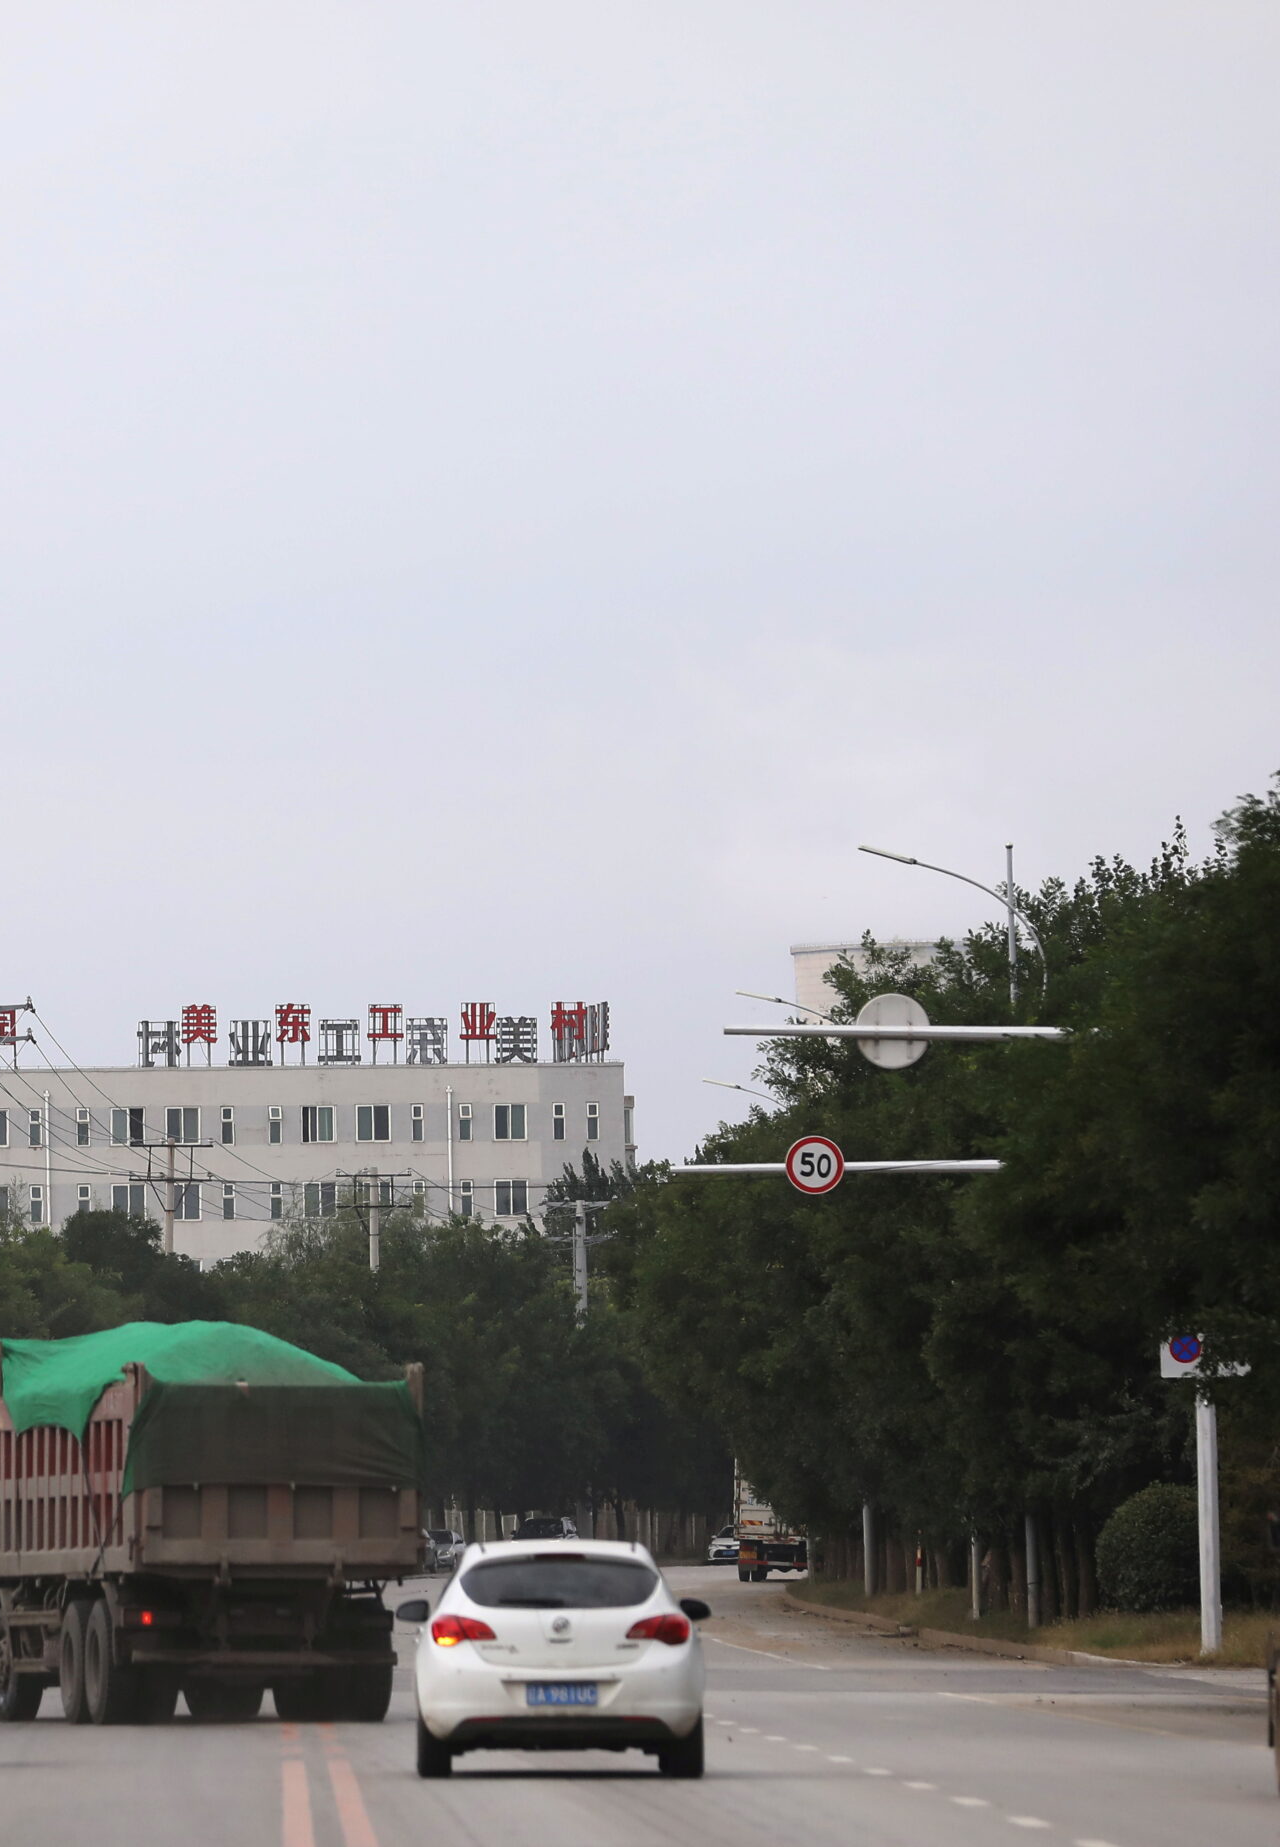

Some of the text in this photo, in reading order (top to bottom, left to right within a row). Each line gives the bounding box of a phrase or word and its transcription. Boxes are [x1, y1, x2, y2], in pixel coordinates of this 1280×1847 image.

[181, 1001, 587, 1043] 美东工业村
[800, 1152, 832, 1178] 50
